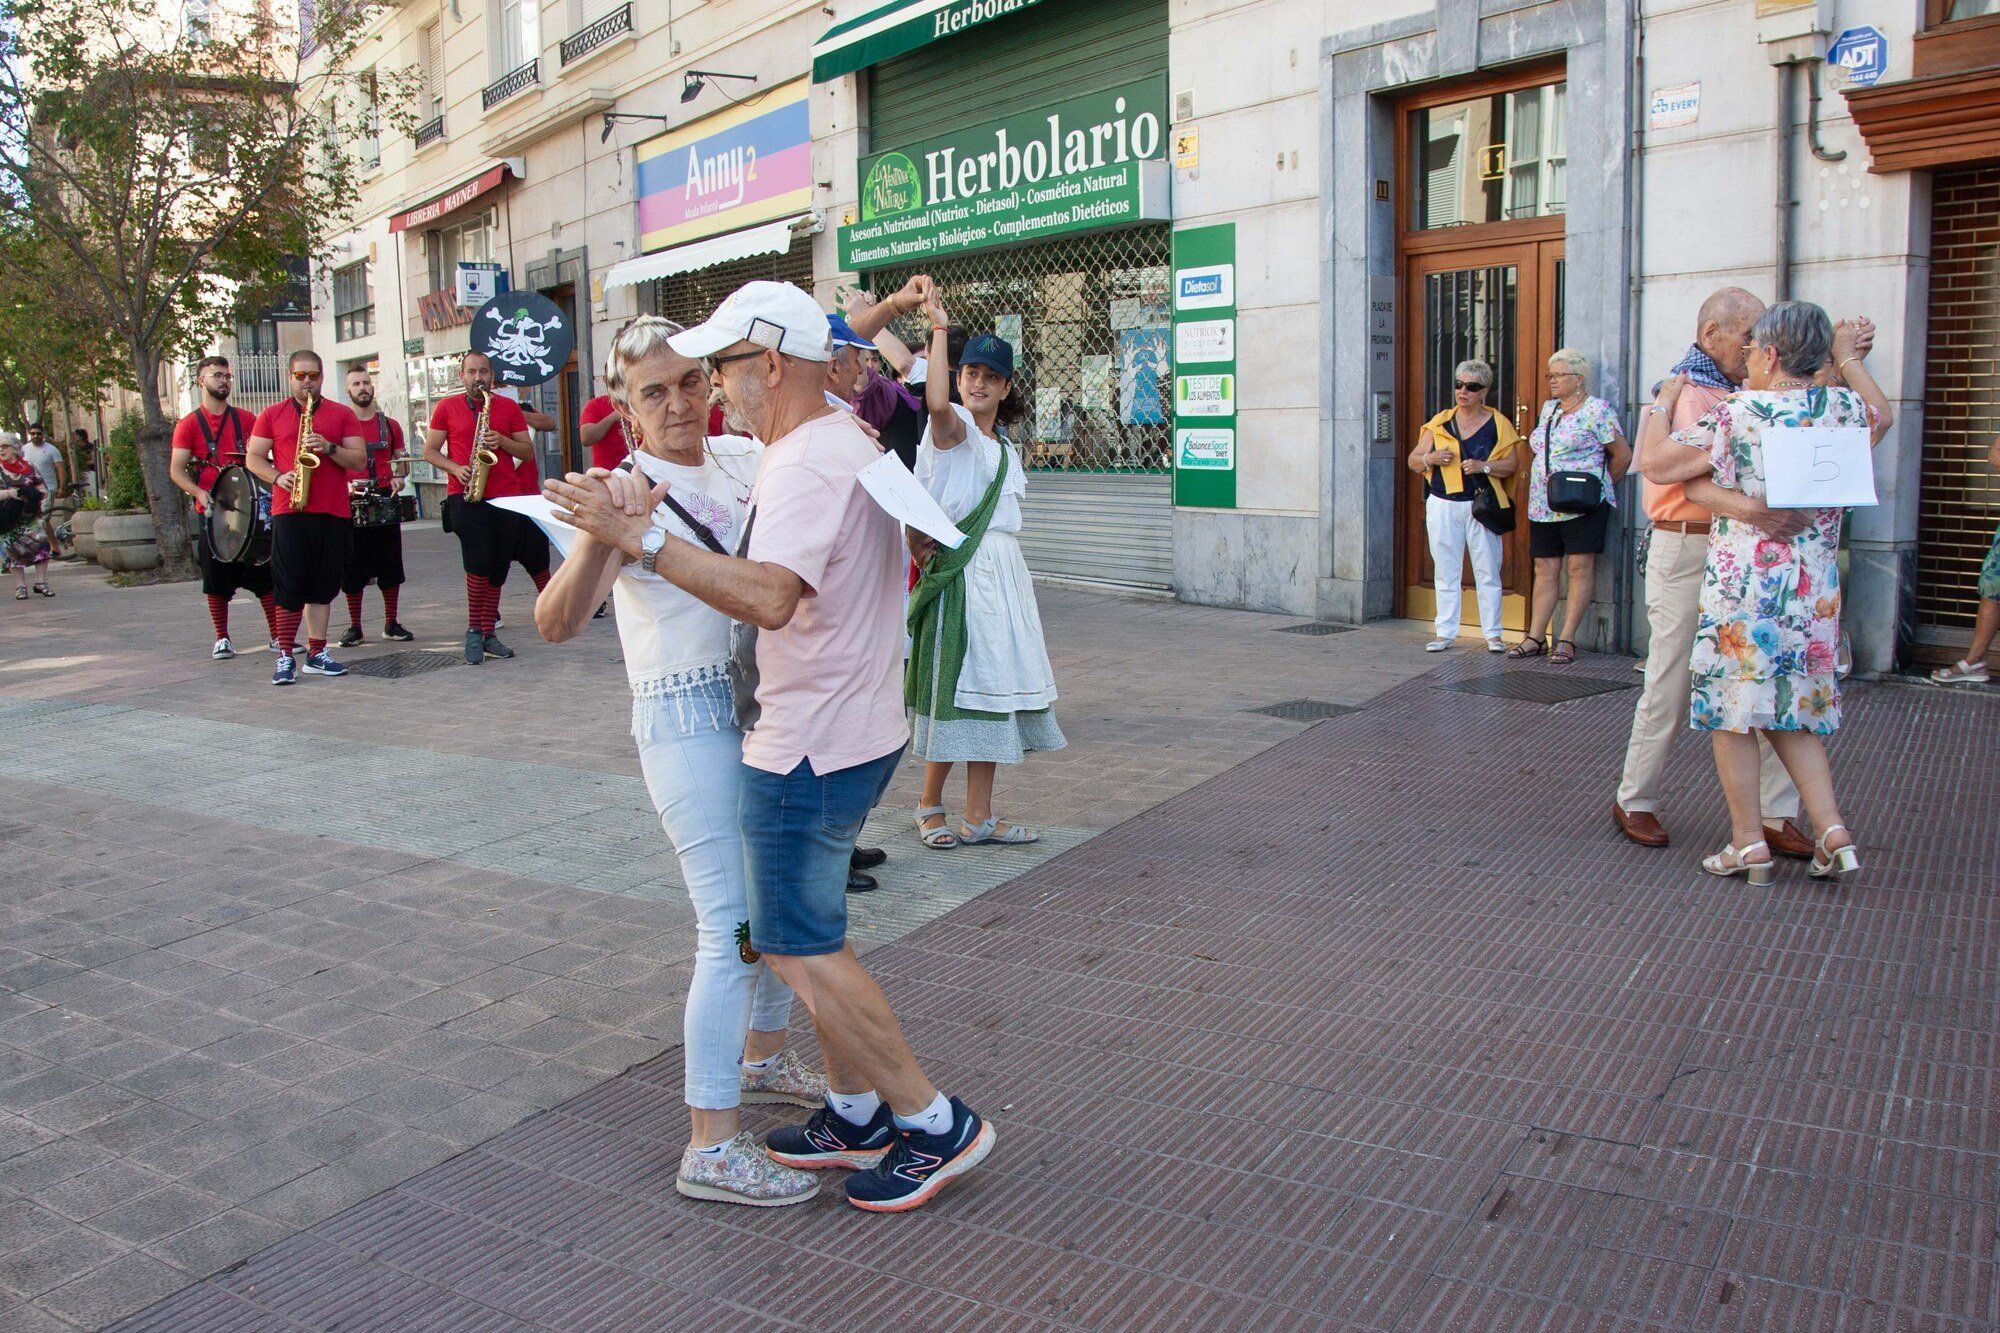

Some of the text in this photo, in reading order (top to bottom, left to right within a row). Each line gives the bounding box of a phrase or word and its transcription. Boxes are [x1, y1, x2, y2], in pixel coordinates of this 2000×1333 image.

[1840, 43, 1877, 68] ADT
[925, 97, 1159, 206] Herbolario
[1483, 150, 1504, 174] 11
[685, 145, 757, 210] Anny 2
[406, 181, 479, 227] LIBRERIA MAYNER
[850, 222, 882, 242] Asesoría
[883, 211, 930, 236] Nutricional
[931, 204, 969, 227] (Nutriox
[976, 191, 1019, 215] Dietasol)
[1027, 180, 1081, 205] Cosmética
[1083, 168, 1127, 194] Natural
[850, 245, 889, 264] Alimentos
[890, 236, 931, 256] Naturales
[932, 240, 937, 251] y
[939, 226, 986, 247] Biológicos
[993, 211, 1070, 237] Complementos
[1072, 199, 1130, 222] Dietéticos
[1184, 277, 1217, 294] Dietasol
[1184, 326, 1218, 338] NUTRIOX
[1188, 377, 1221, 390] TEST DE
[1812, 444, 1841, 482] 5
